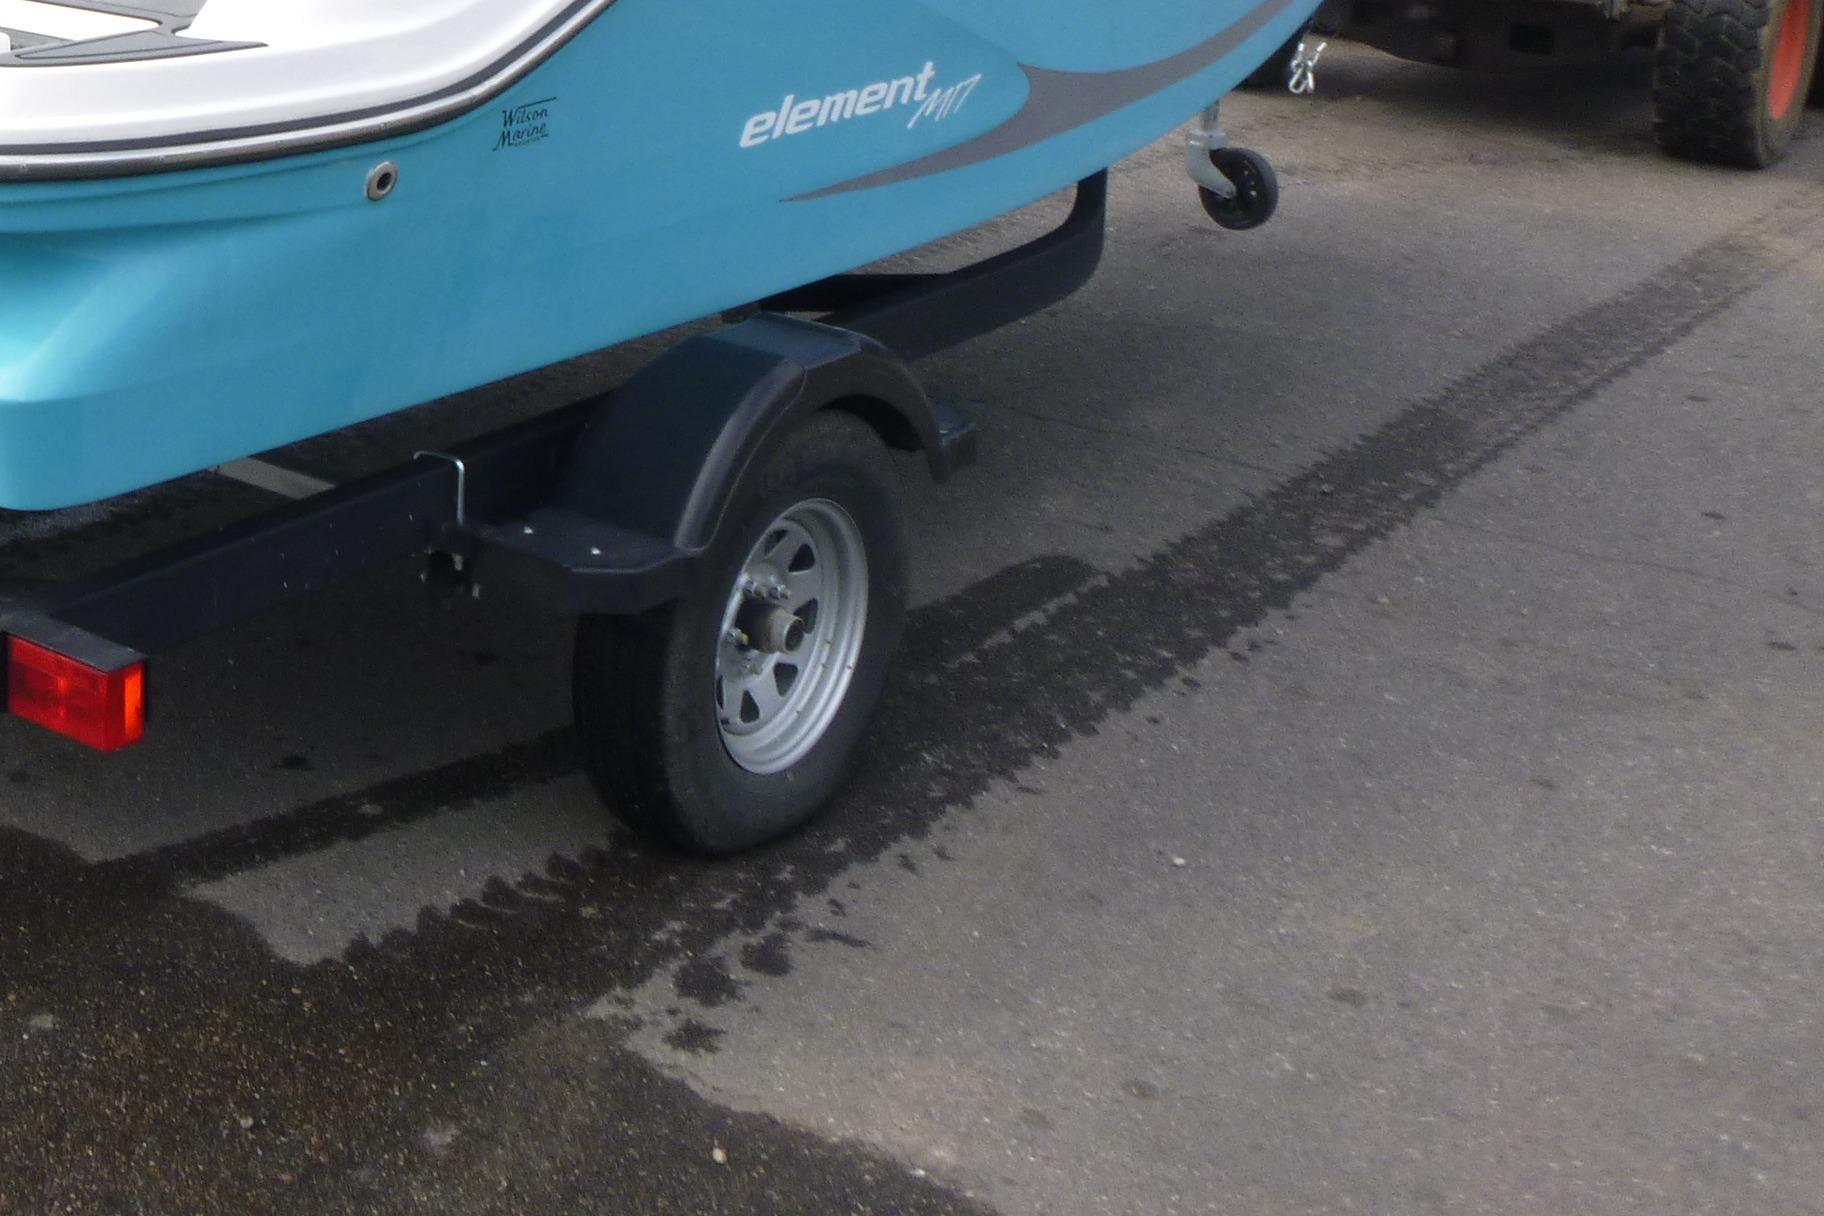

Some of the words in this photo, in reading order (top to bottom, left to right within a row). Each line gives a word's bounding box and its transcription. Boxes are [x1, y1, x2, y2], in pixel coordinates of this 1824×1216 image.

[502, 104, 550, 128] Wilson
[739, 60, 935, 148] element
[493, 122, 549, 151] Marine
